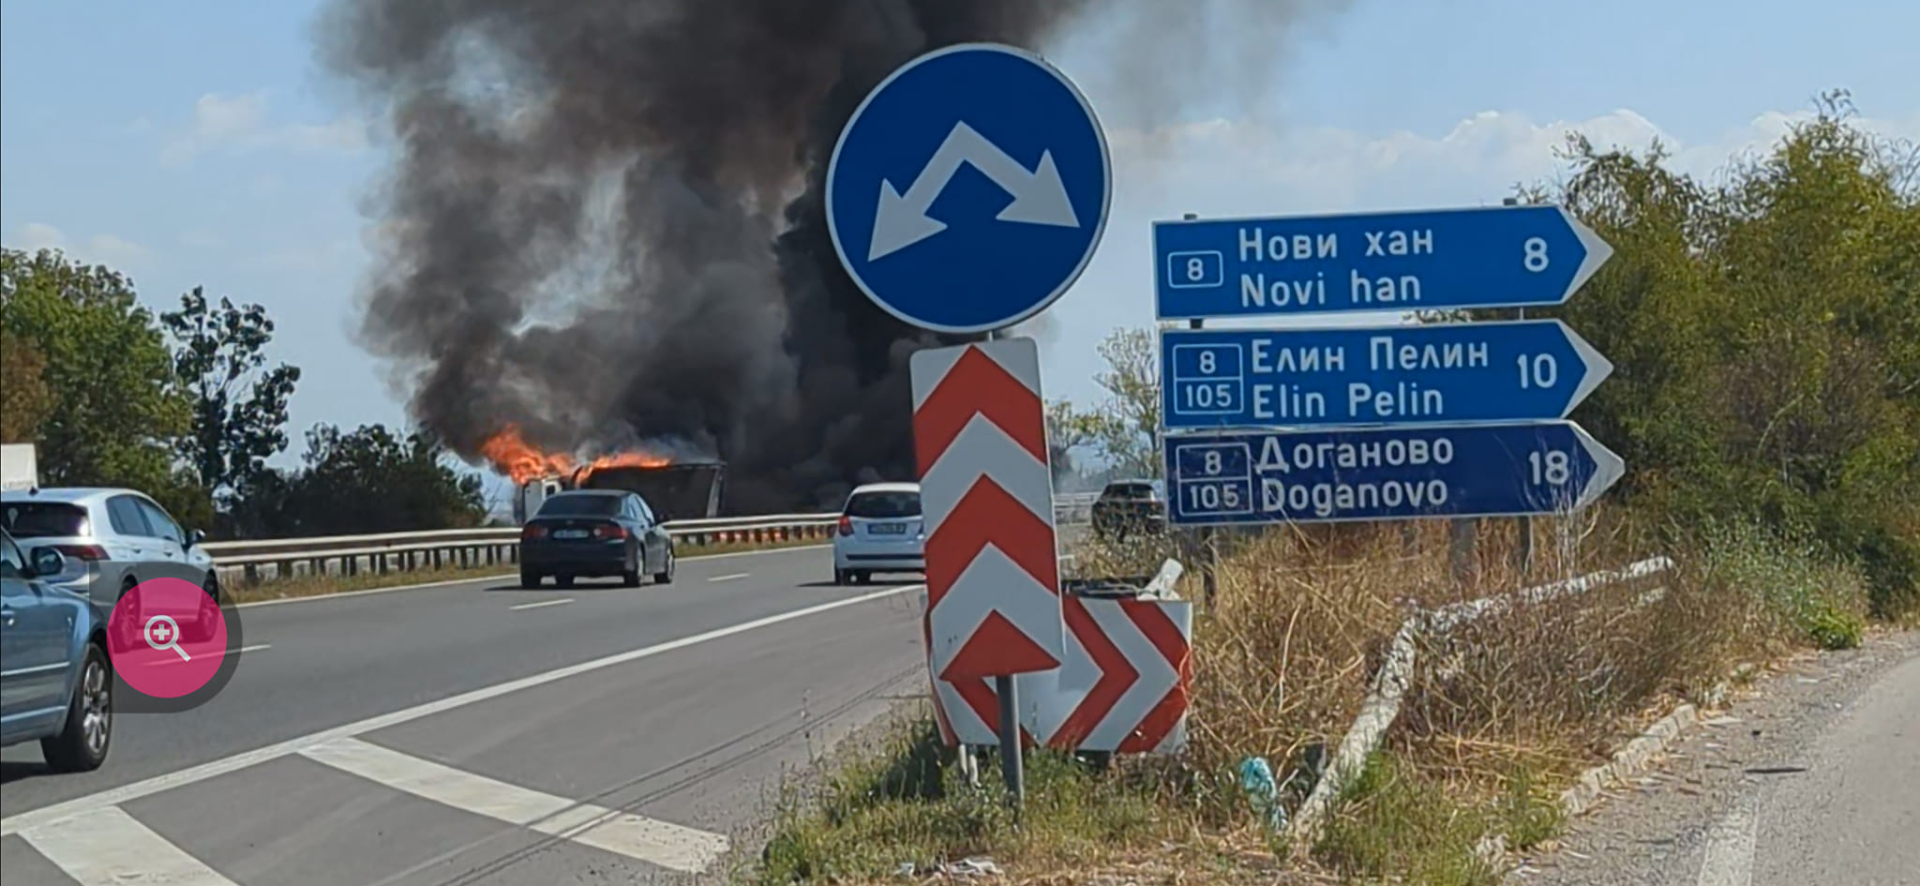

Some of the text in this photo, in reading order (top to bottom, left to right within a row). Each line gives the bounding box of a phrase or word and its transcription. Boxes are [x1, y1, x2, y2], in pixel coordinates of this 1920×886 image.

[1240, 228, 1432, 261] Нови хан
[1525, 238, 1548, 272] 8
[1188, 258, 1203, 280] 8
[1242, 270, 1420, 307] Novi han
[1200, 351, 1215, 373] 8
[1252, 337, 1487, 372] Елин Пелин
[1518, 354, 1556, 388] 10
[1186, 384, 1231, 407] 105
[1254, 382, 1442, 418] Elin Pelin
[1205, 451, 1222, 475] 8
[1256, 436, 1453, 473] Доганово
[1530, 451, 1569, 485] 18
[1191, 484, 1239, 508] 105
[1262, 479, 1448, 516] Doganovo
